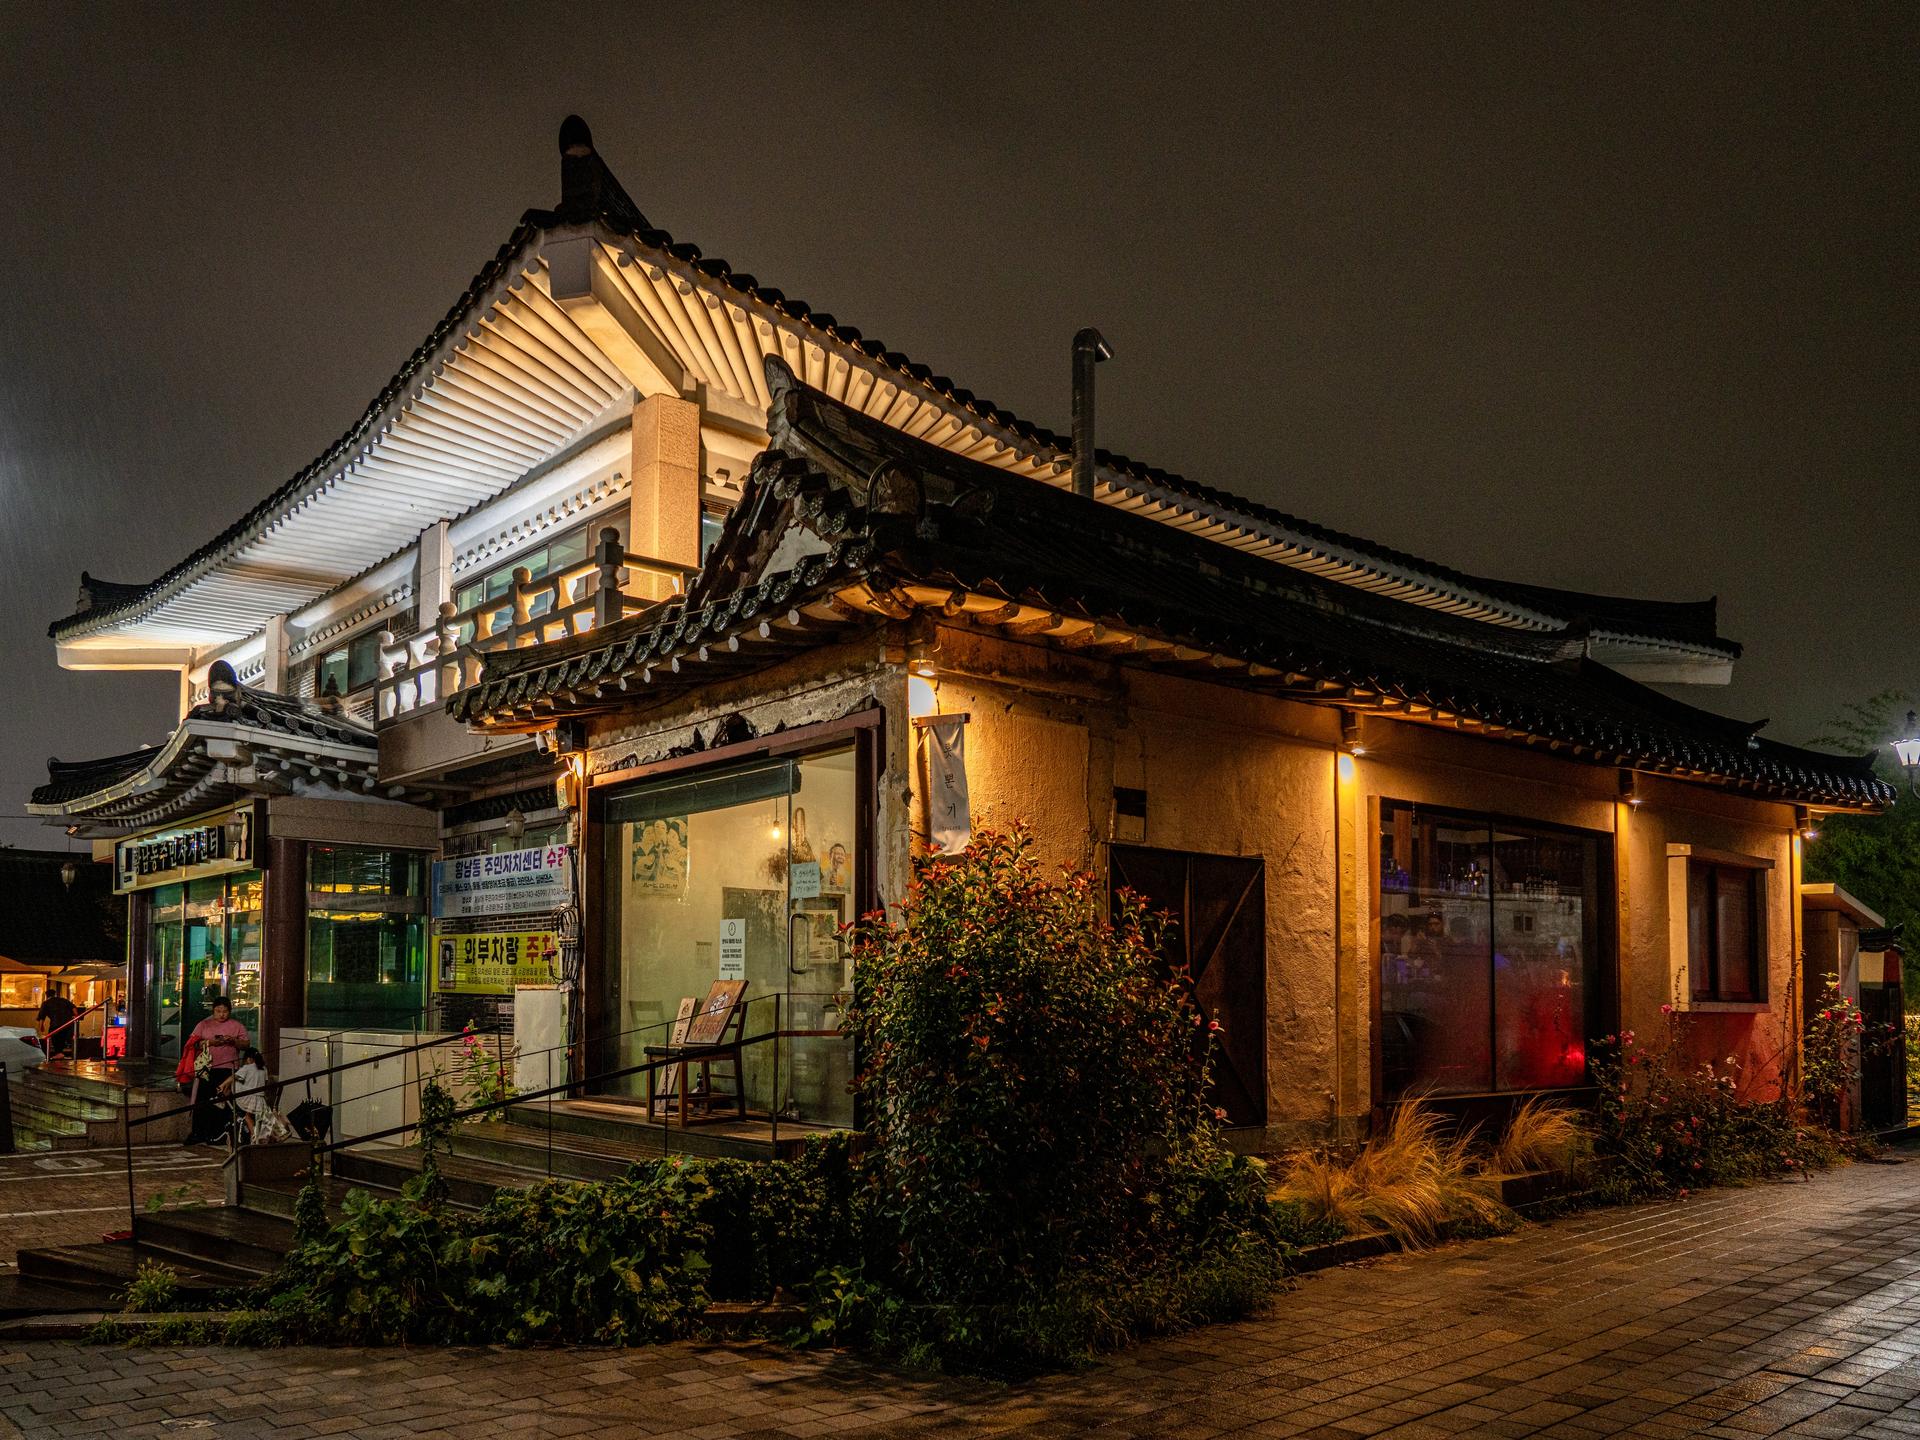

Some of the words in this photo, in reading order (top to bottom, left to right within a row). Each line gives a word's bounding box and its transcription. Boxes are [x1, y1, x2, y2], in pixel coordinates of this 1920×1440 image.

[455, 858, 481, 880] 황남동
[484, 849, 543, 876] 주민자치센터
[464, 936, 519, 965] 외부차량
